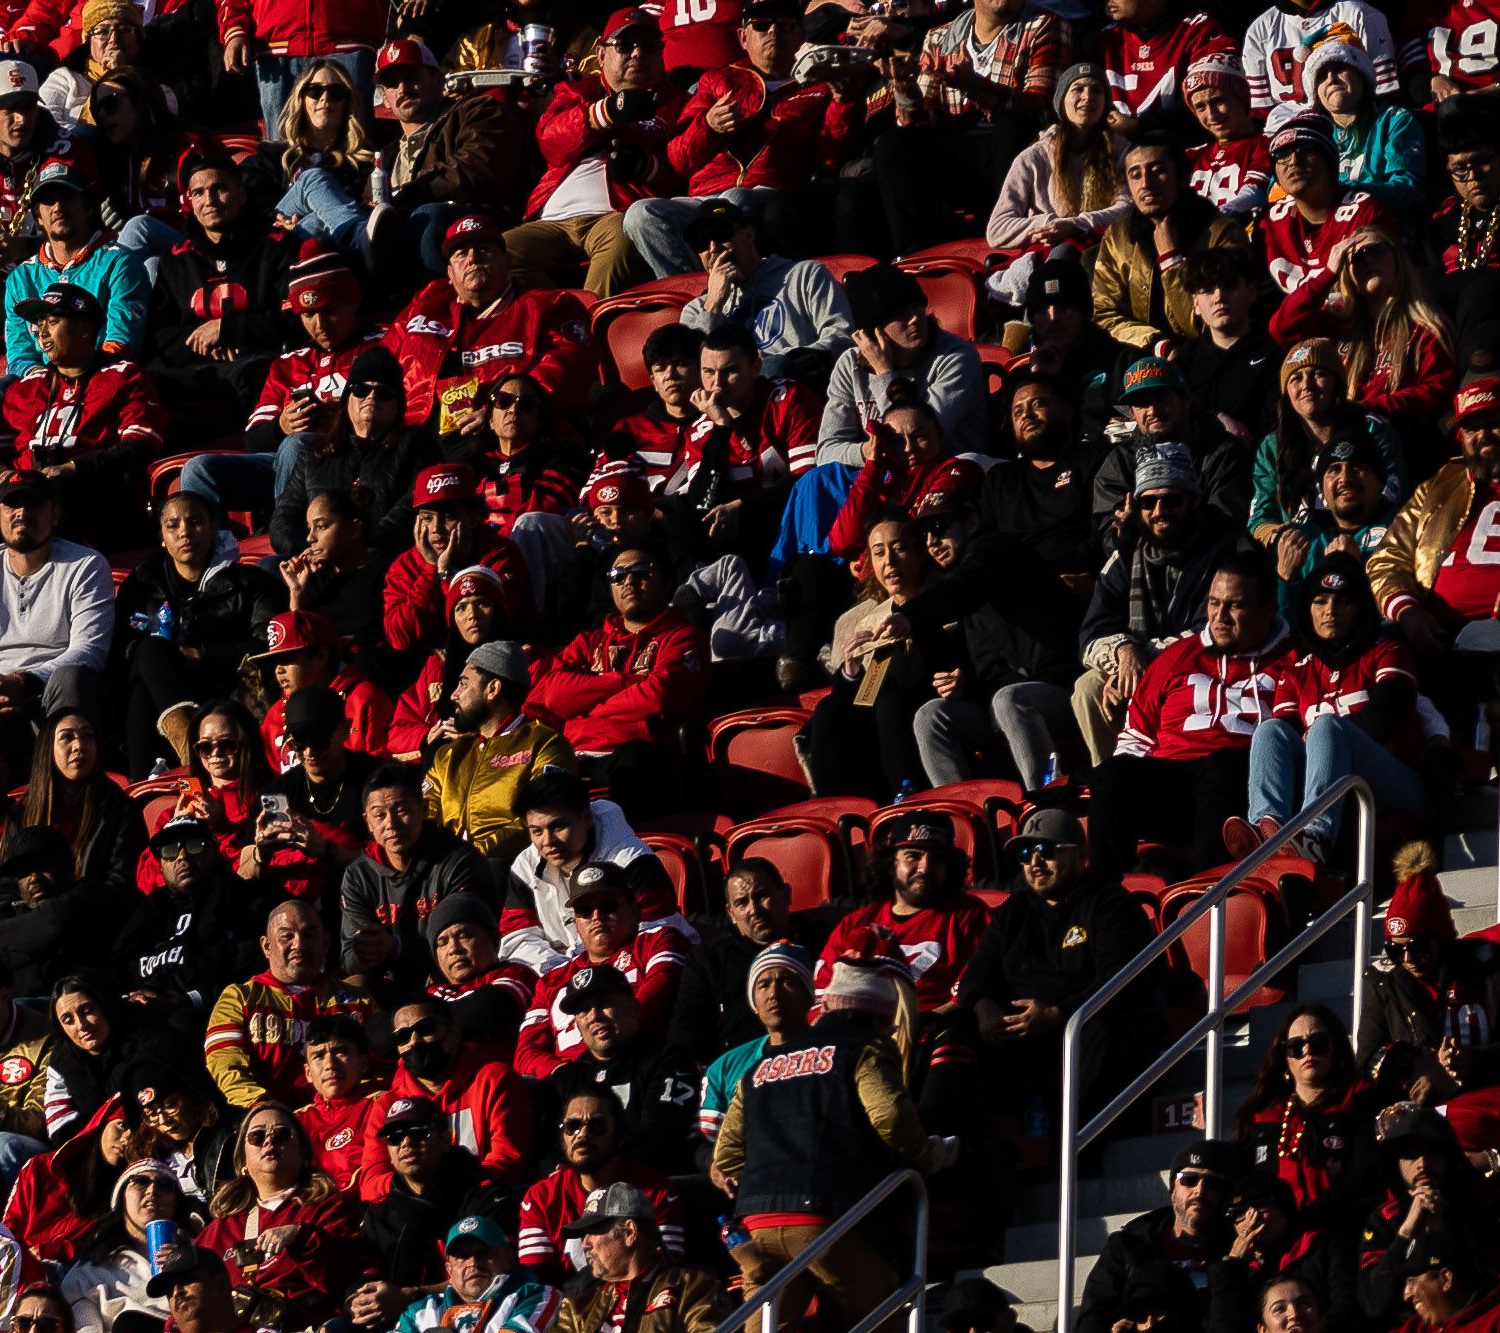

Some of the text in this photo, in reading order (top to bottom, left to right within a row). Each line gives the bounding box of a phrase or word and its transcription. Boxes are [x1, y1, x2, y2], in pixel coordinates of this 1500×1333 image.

[1433, 20, 1498, 75] 19
[754, 1046, 834, 1088] 49ERS
[660, 1078, 695, 1106] 17
